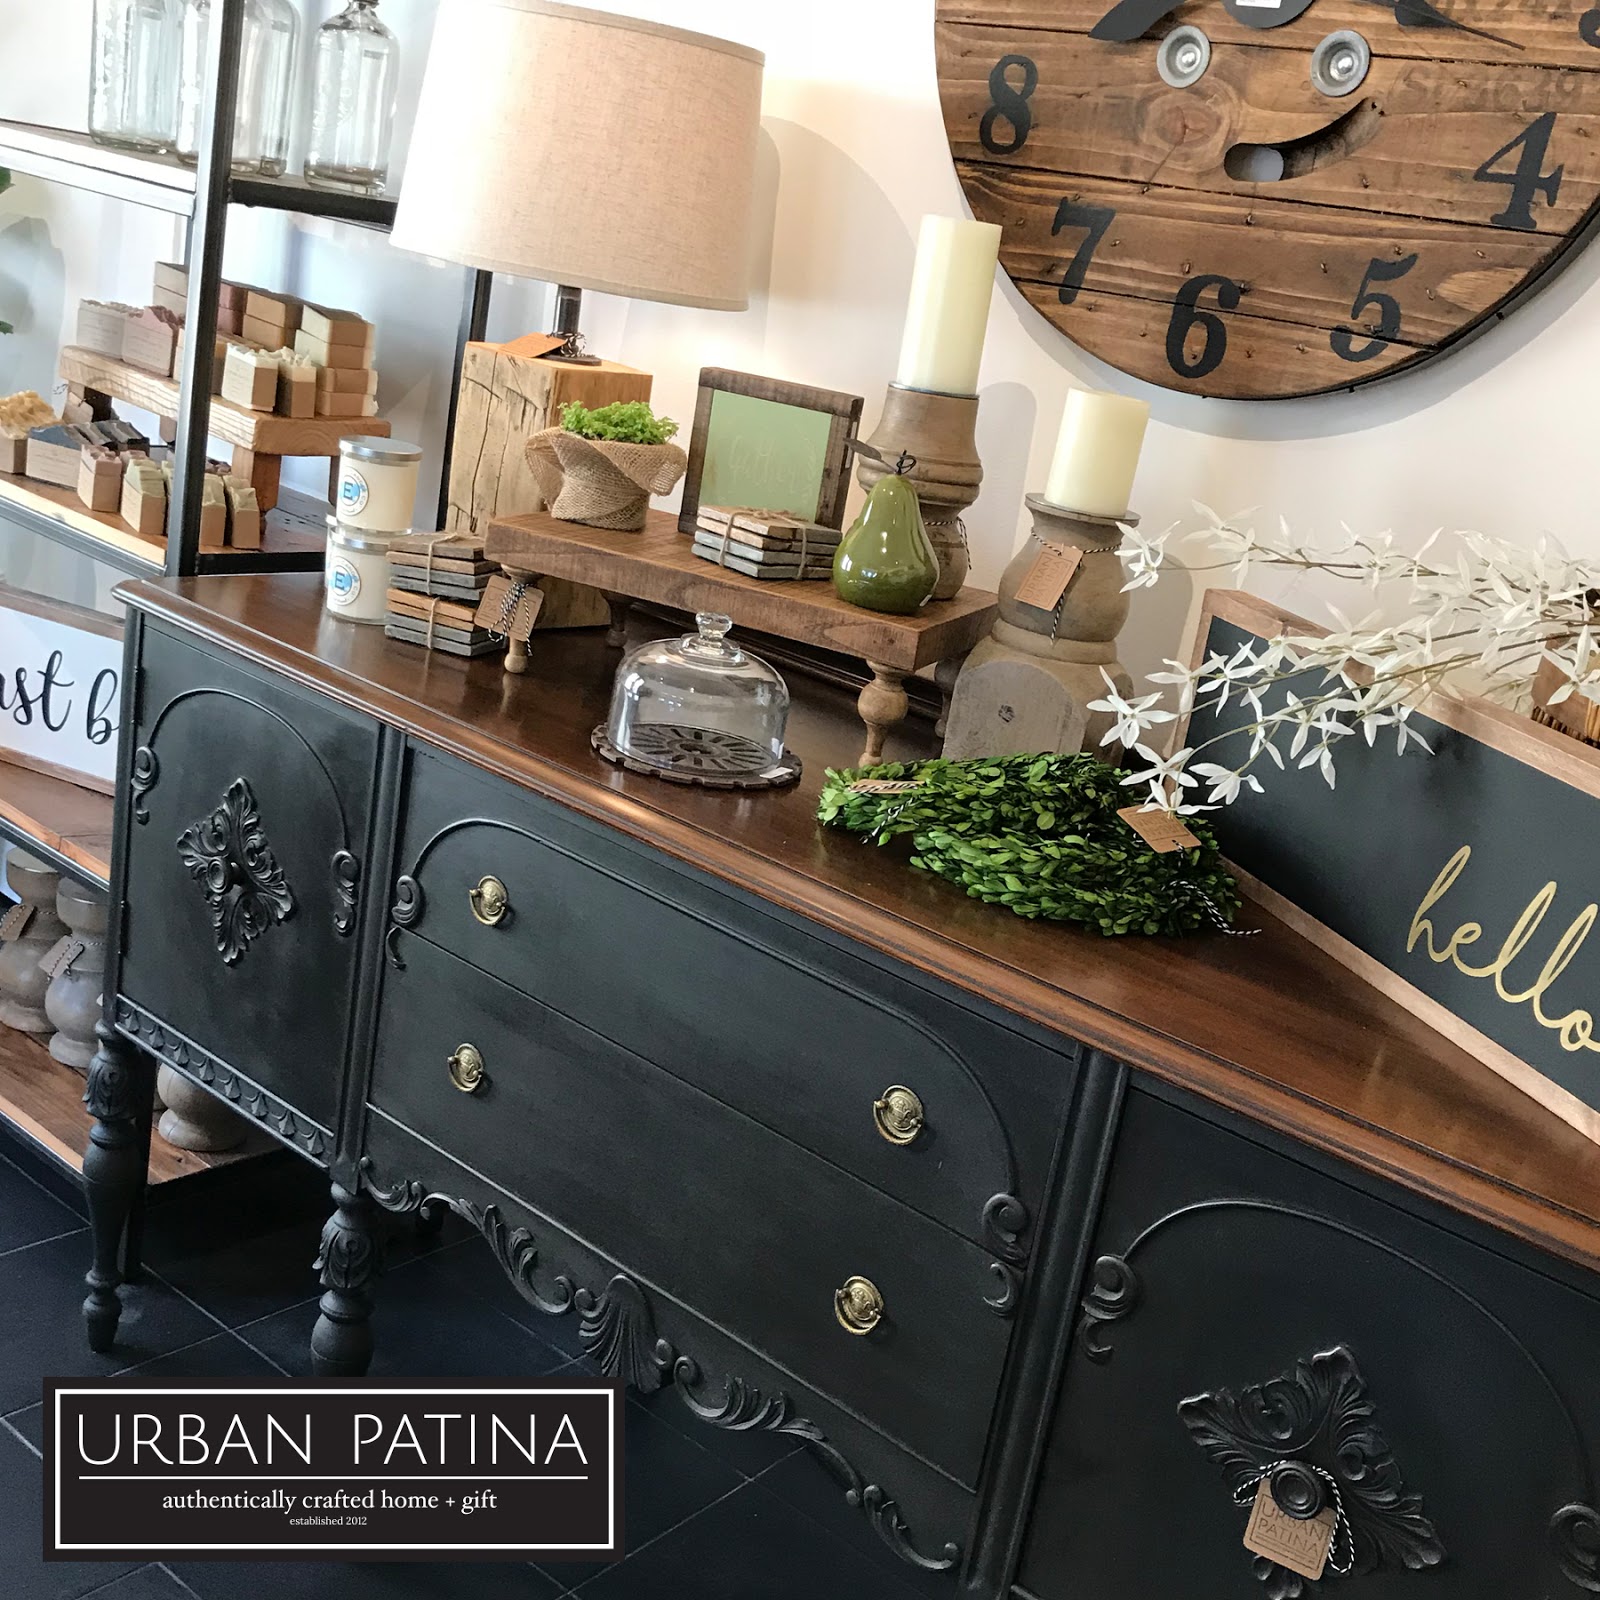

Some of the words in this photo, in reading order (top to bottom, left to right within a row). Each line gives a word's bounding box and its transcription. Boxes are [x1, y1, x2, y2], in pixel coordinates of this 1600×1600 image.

[979, 54, 1038, 155] 8
[1474, 111, 1564, 229] 4
[1051, 197, 1116, 305] 7
[1165, 274, 1240, 379] 6
[1330, 253, 1418, 362] 5
[1406, 845, 1600, 1053] hello
[1258, 1517, 1319, 1557] PATINA
